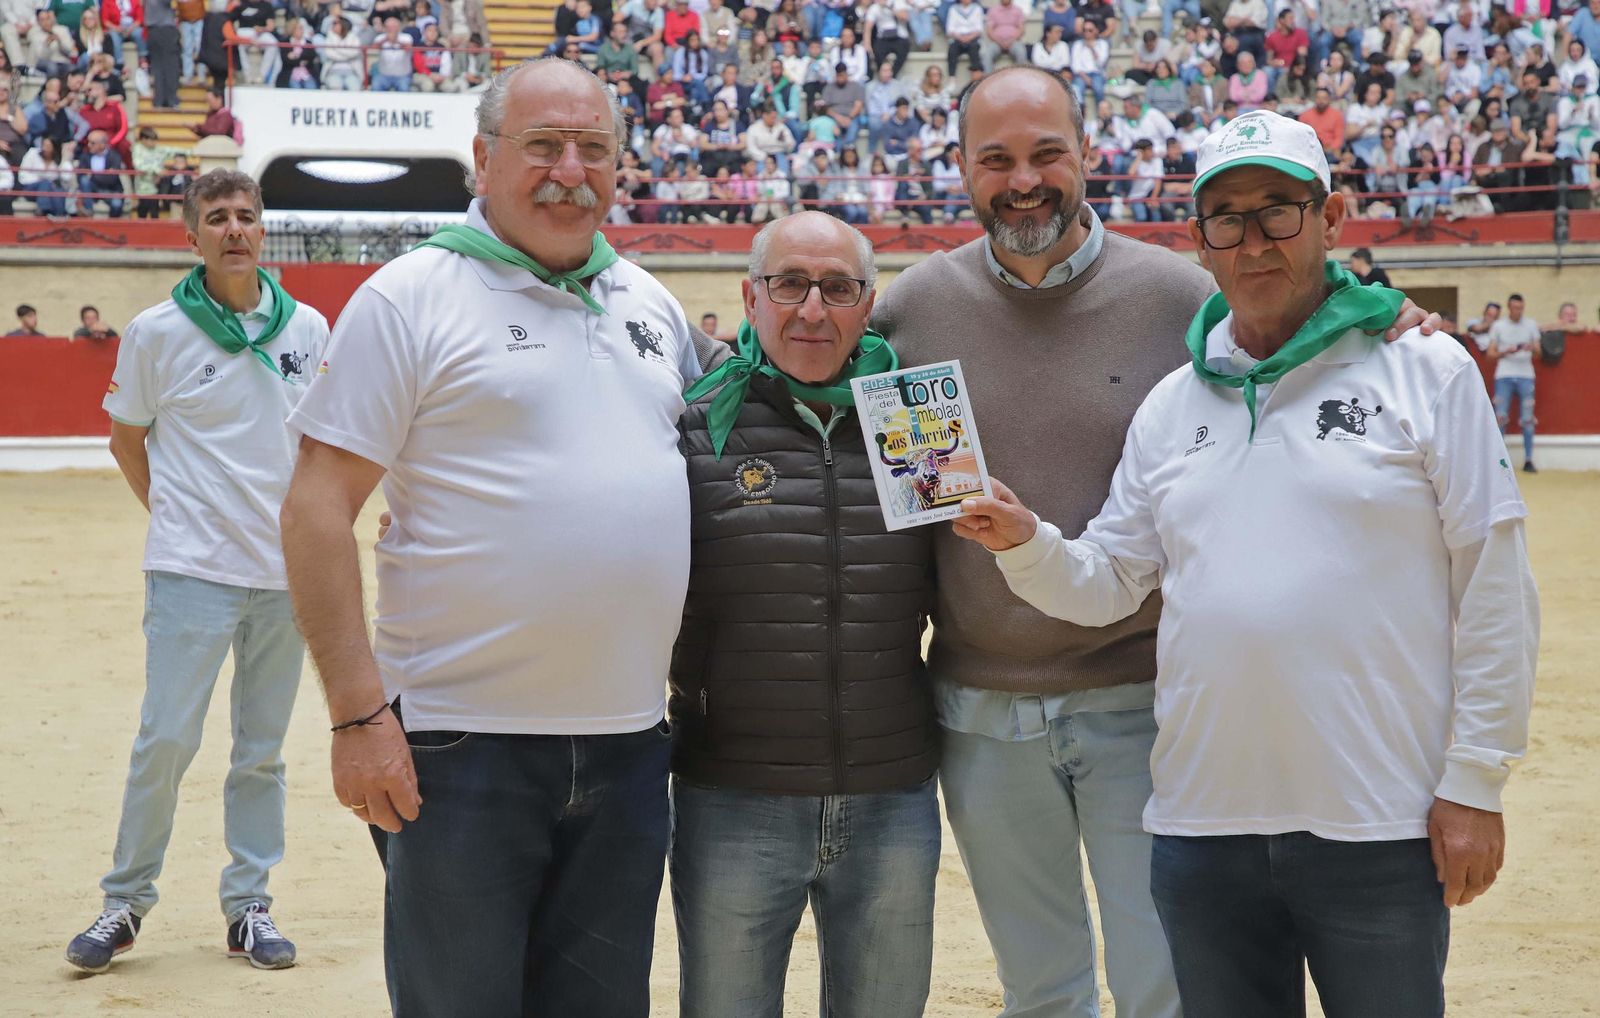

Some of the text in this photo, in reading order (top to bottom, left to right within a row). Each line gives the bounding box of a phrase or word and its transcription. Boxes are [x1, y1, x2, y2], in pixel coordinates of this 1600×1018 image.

[291, 108, 433, 129] PUERTA GRANDE
[863, 378, 895, 391] 2025
[894, 375, 958, 408] toro
[867, 390, 900, 401] Fiesta
[879, 398, 897, 409] del
[755, 458, 776, 475] TAURINA
[735, 478, 749, 495] TORO
